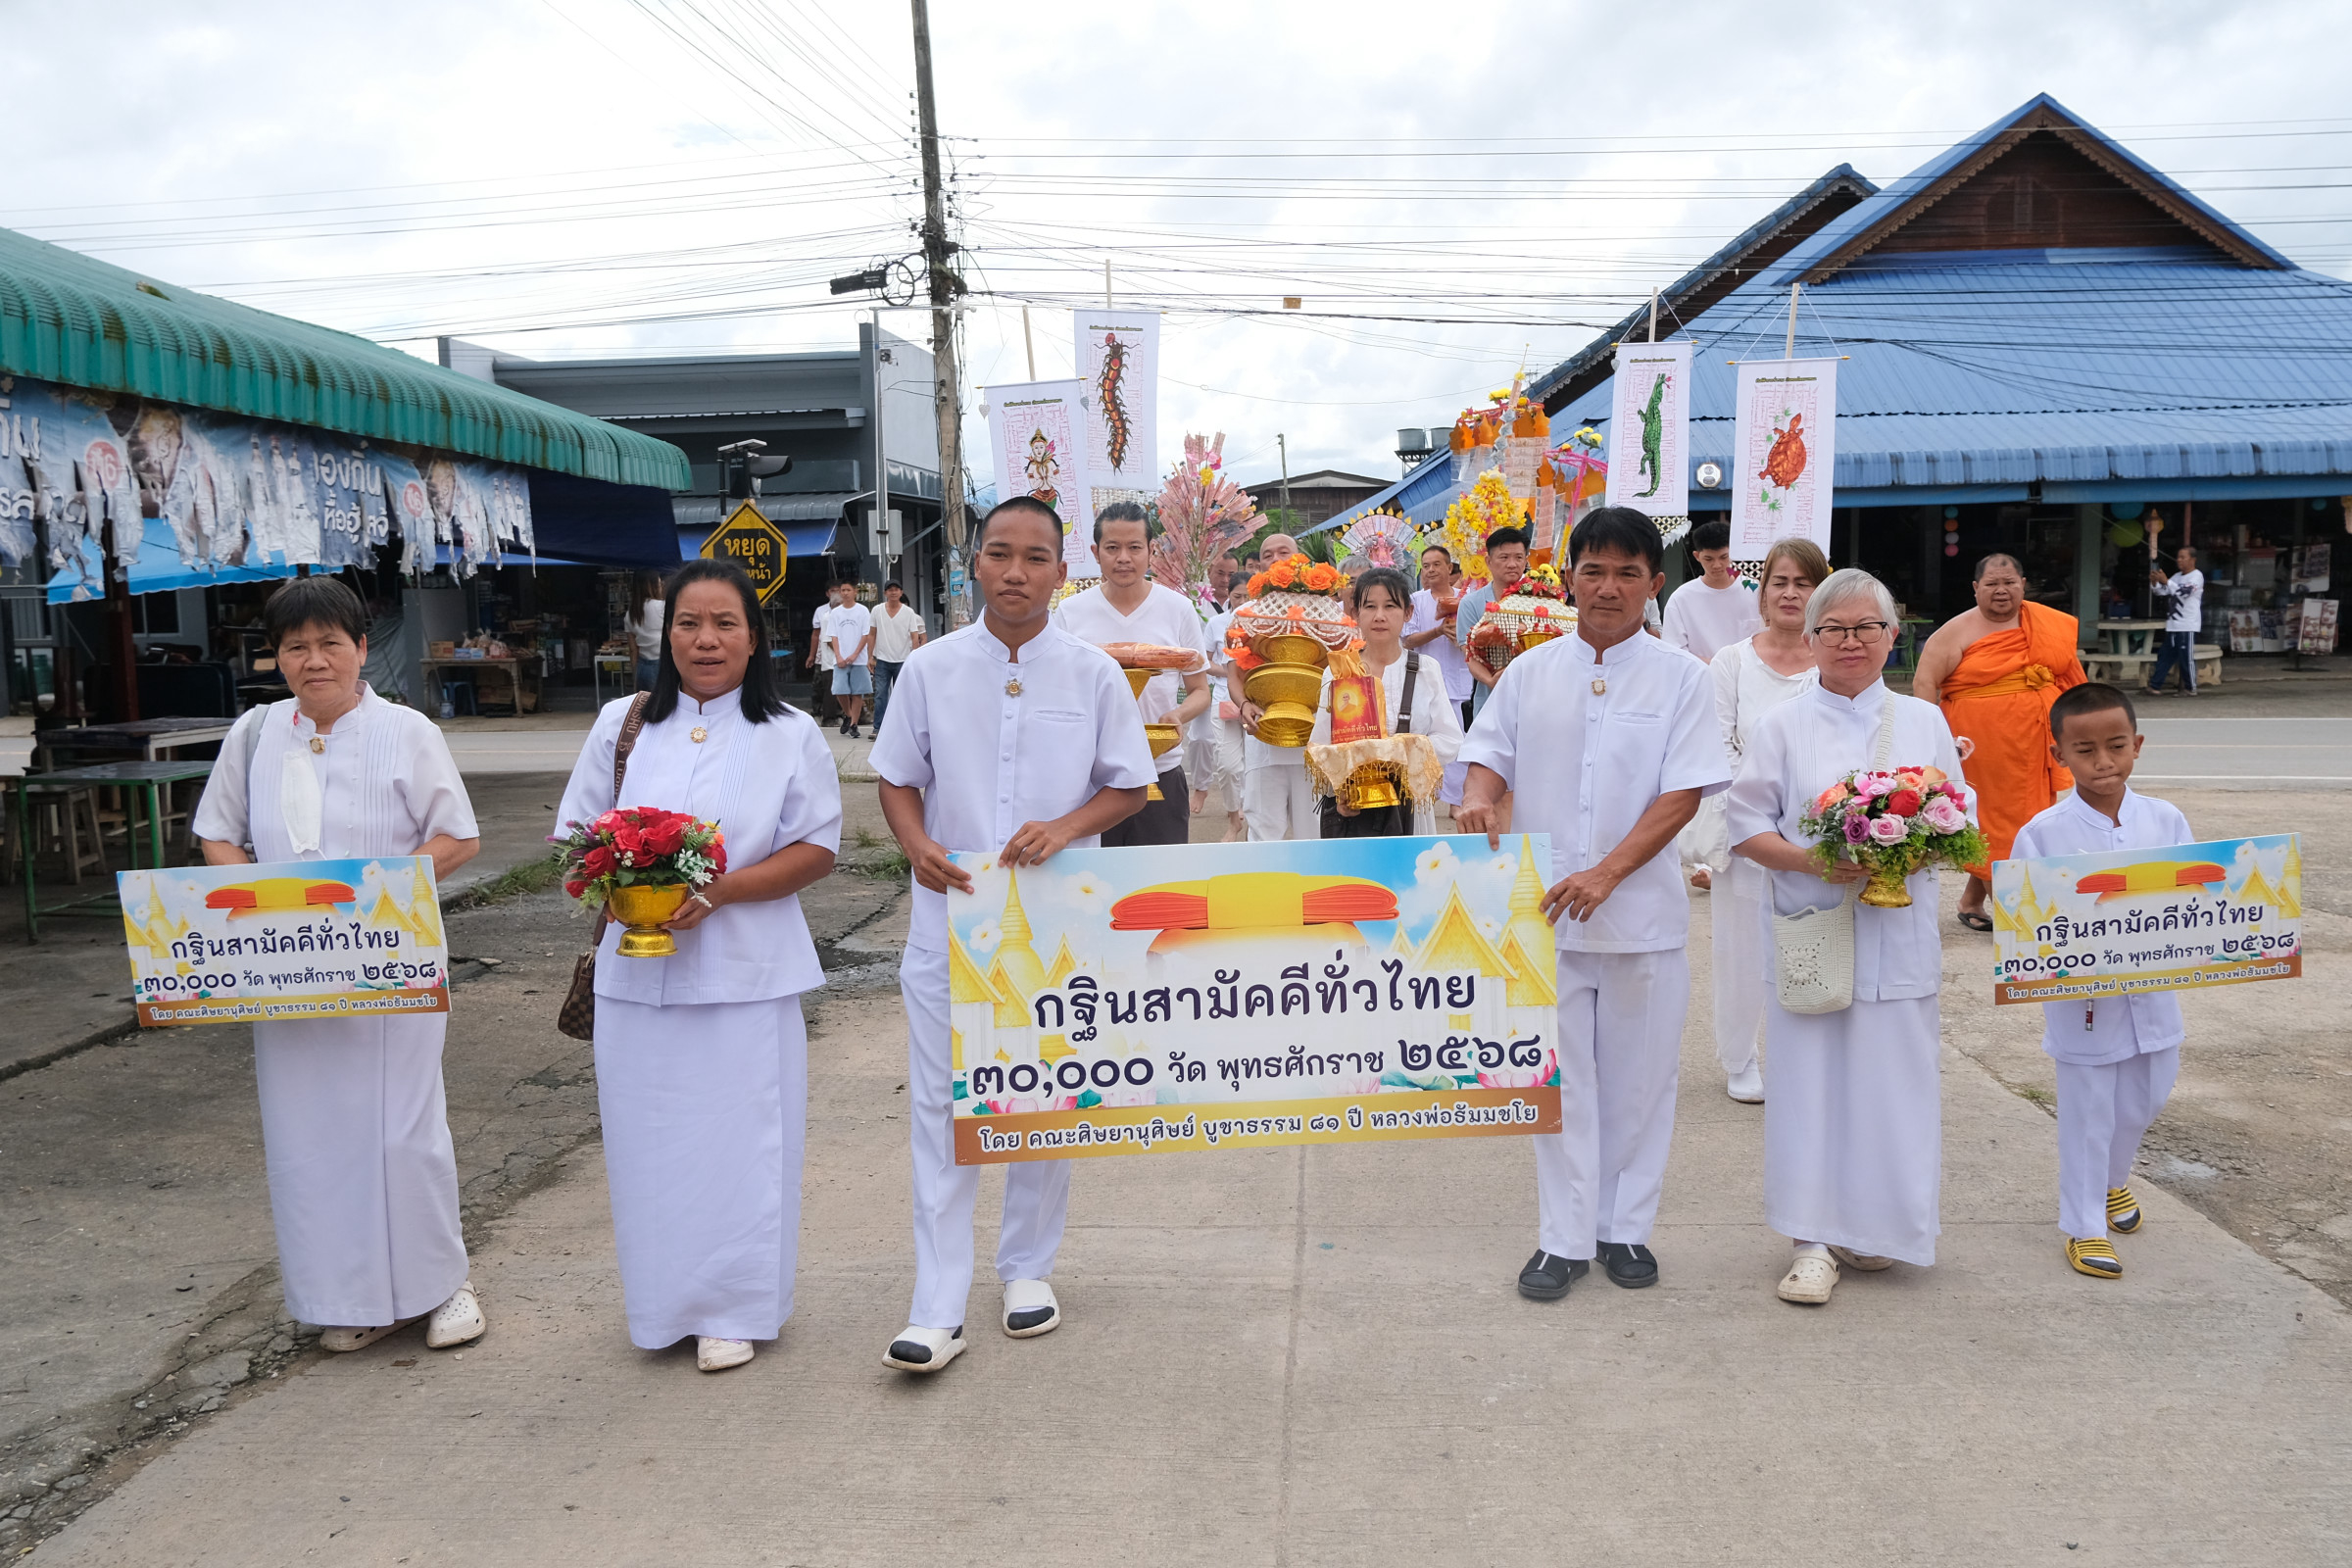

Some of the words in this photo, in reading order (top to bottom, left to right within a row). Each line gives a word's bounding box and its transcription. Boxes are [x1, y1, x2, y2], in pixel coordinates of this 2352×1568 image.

[723, 537, 771, 566] หยุด
[745, 563, 771, 580] หน้า
[171, 917, 400, 965] กฐินสามัคคีทั่วไทย
[2035, 897, 2264, 948] กฐินสามัคคีทั่วไทย
[2004, 953, 2096, 974] ๓๐,๐๐๐
[2103, 949, 2124, 965] วัด
[2128, 943, 2215, 967] พุทธศักราช
[2223, 931, 2295, 954] ๒๕๖๘
[144, 973, 237, 994] ๓๐,๐๐๐
[243, 969, 265, 987] วัด
[269, 966, 356, 992] พุทธศักราช
[362, 960, 437, 981] ๒๕๖๘
[1035, 949, 1476, 1042] กฐินสามัคคีทั่วไทย
[2008, 989, 2028, 999] โดย
[2032, 979, 2117, 996] คณะศิษยานุศิษย์
[2120, 978, 2170, 992] บูชาธรรม
[2193, 971, 2202, 982] ปี
[2205, 963, 2290, 981] หลวงพ่อธัมมชโย
[151, 1007, 172, 1019] โดย
[176, 1002, 262, 1019] คณะศิษยานุศิษย์
[265, 1003, 317, 1017] บูชาธรรม
[319, 1003, 336, 1011] ๘๑
[339, 999, 348, 1010] ปี
[351, 995, 437, 1009] หลวงพ่อธัมมชโย
[972, 1057, 1154, 1099] ๓๐,๐๐๐
[1167, 1051, 1206, 1083] วัด
[1216, 1045, 1385, 1093] พุทธศักราช
[1397, 1034, 1543, 1072] ๒๕๖๘
[980, 1128, 1020, 1150] โดย
[1029, 1113, 1196, 1148] คณะศิษยานุศิษย์
[1202, 1115, 1301, 1144] บูชาธรรม
[1310, 1114, 1341, 1131] ๘๑
[1348, 1107, 1362, 1128] ปี
[1370, 1102, 1537, 1128] หลวงพ่อธัมมชโย
